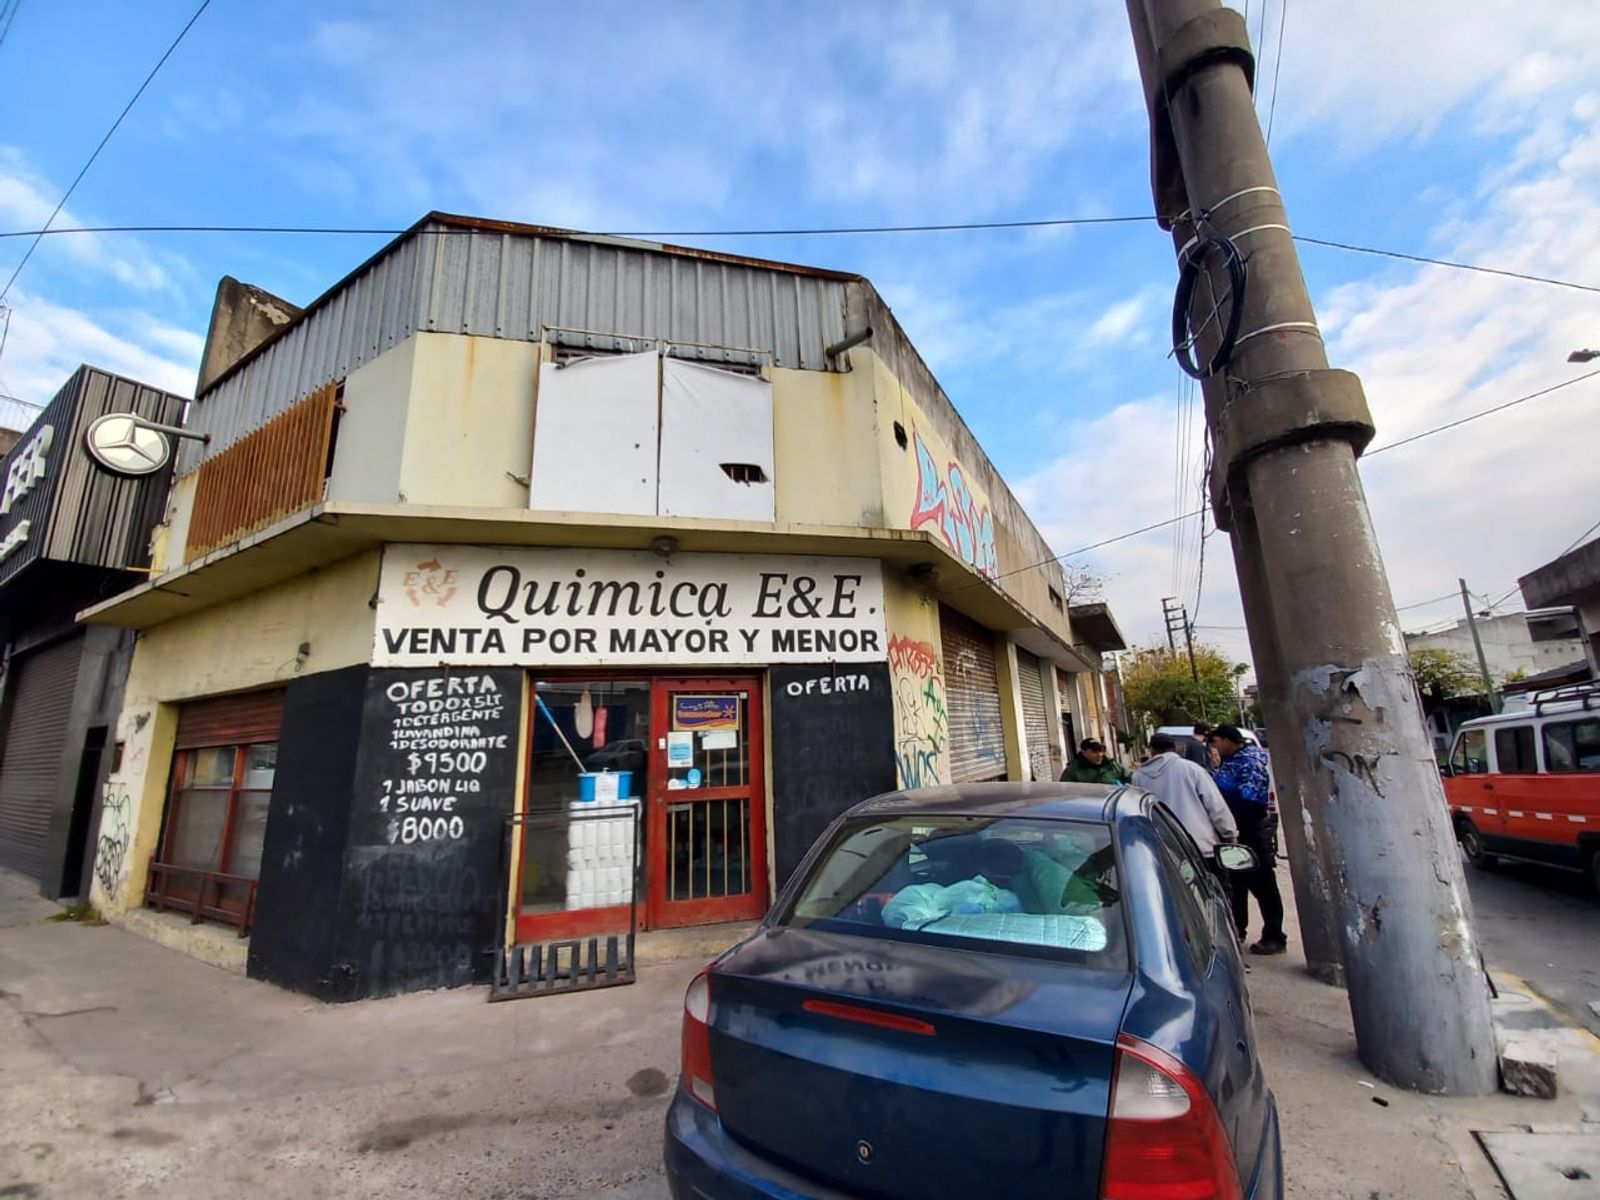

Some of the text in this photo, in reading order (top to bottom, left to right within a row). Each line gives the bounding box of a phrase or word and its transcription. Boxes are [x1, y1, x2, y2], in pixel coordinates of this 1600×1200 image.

[477, 565, 732, 624] Quimica
[382, 628, 880, 654] VENTA POR MAYOR Y MENOR
[386, 675, 498, 702] OFERTA
[787, 674, 870, 696] OFERTA
[407, 751, 487, 775] $9500
[382, 780, 393, 793] 1
[380, 795, 457, 812] 1 SUAVE
